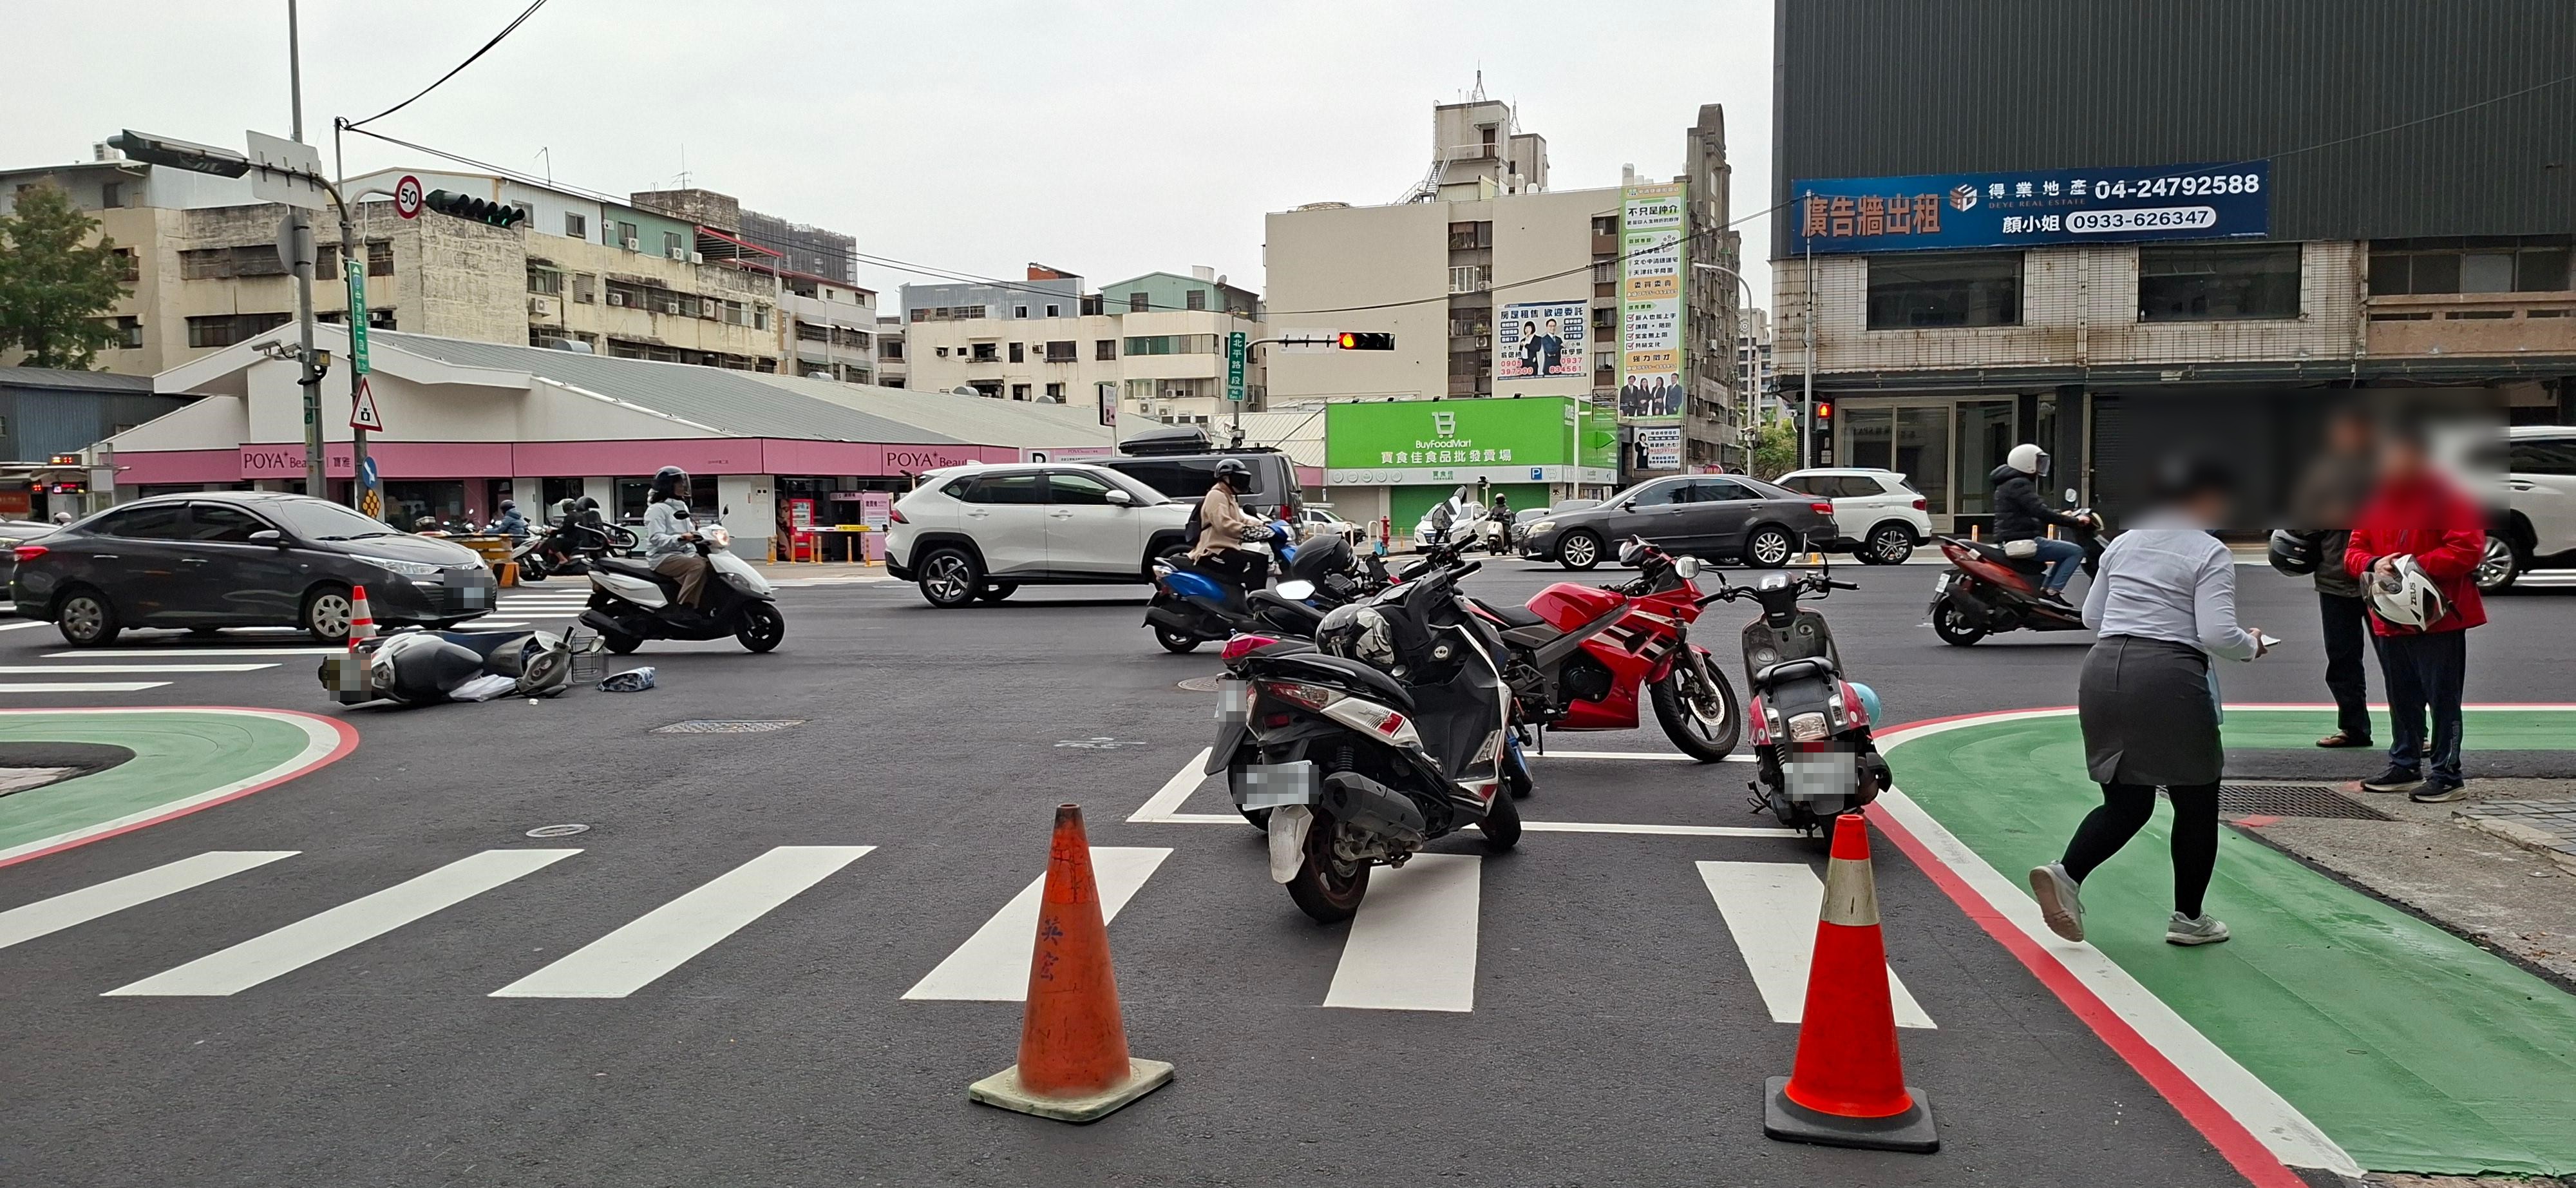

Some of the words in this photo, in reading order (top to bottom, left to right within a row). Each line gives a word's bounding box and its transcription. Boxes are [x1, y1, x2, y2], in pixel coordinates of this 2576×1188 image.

[1988, 179, 2087, 200] 得業地產
[2094, 174, 2260, 200] 04-24792588
[401, 187, 417, 206] 50
[2048, 198, 2086, 206] ESTATE
[1628, 204, 1678, 217] 不只是仲介
[1801, 193, 1940, 238] 廣告牆出租
[2002, 215, 2061, 234] 顏小姐
[2073, 211, 2210, 229] 0933-626347
[1231, 339, 1242, 385] 北平路一段
[1416, 439, 1472, 450] BuyFoodMart
[244, 453, 285, 469] POYA
[887, 452, 934, 467] POYA
[1380, 449, 1512, 465] 寶食佳食品批發賣場
[1532, 468, 1540, 479] P
